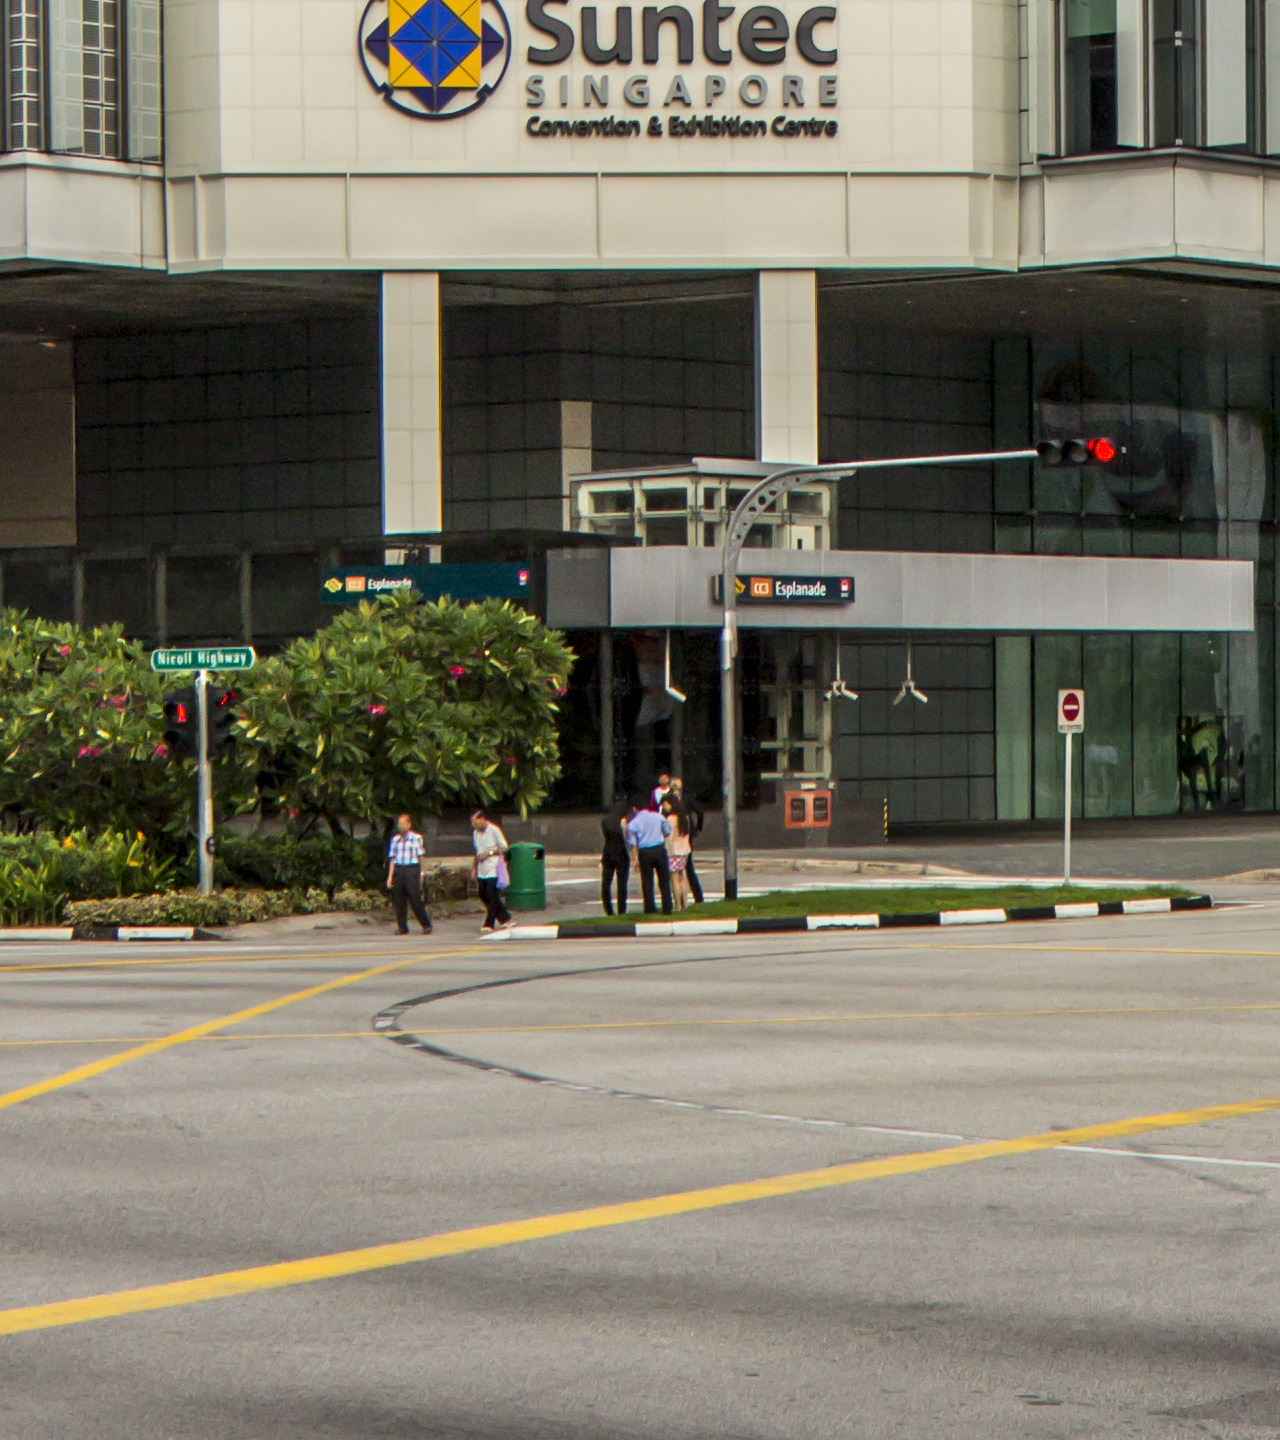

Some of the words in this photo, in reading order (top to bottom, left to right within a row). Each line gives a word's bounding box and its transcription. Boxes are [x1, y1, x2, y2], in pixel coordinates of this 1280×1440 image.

[526, 74, 838, 107] SINGAPORE
[526, 114, 641, 137] Convention
[647, 115, 664, 137] &
[669, 114, 768, 138] Exhibition
[772, 115, 839, 137] Centre
[753, 582, 770, 595] CC3
[775, 581, 827, 599] Esplanade
[158, 651, 192, 666] Nicoll
[197, 650, 247, 668] Highway
